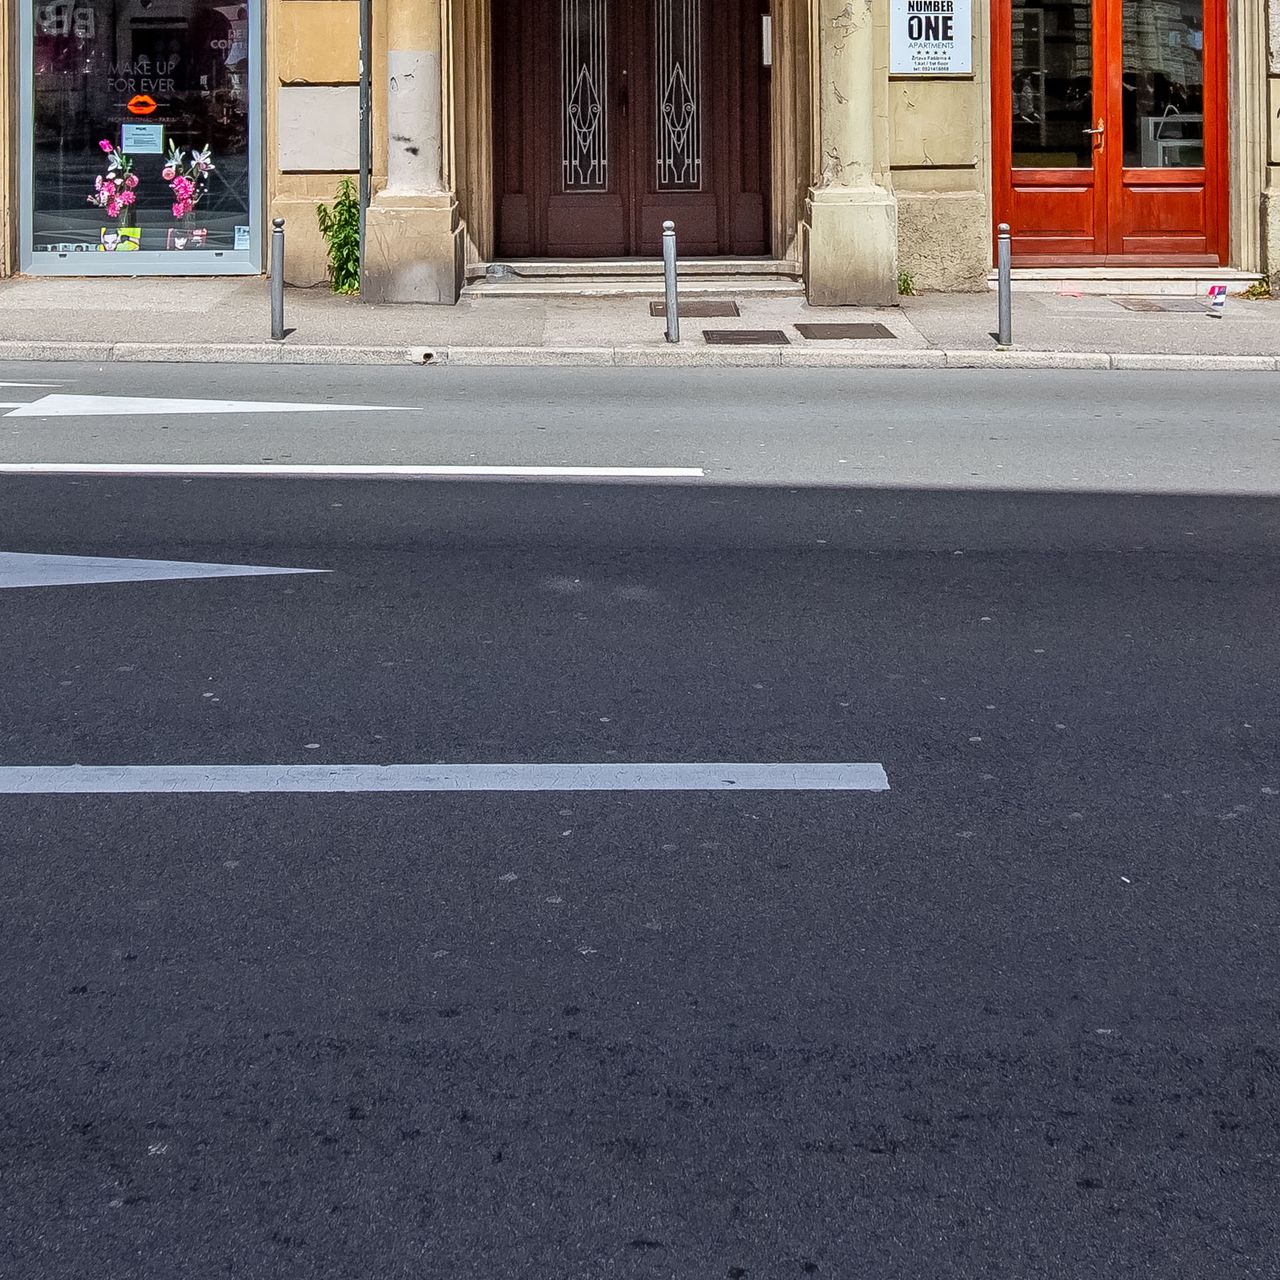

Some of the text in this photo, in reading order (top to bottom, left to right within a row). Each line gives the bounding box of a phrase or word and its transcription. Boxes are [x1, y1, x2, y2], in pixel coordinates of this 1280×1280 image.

[908, 0, 954, 12] NUMBER
[908, 15, 954, 41] ONE
[108, 61, 176, 75] MAKE UP
[108, 78, 176, 92] FOR EVER
